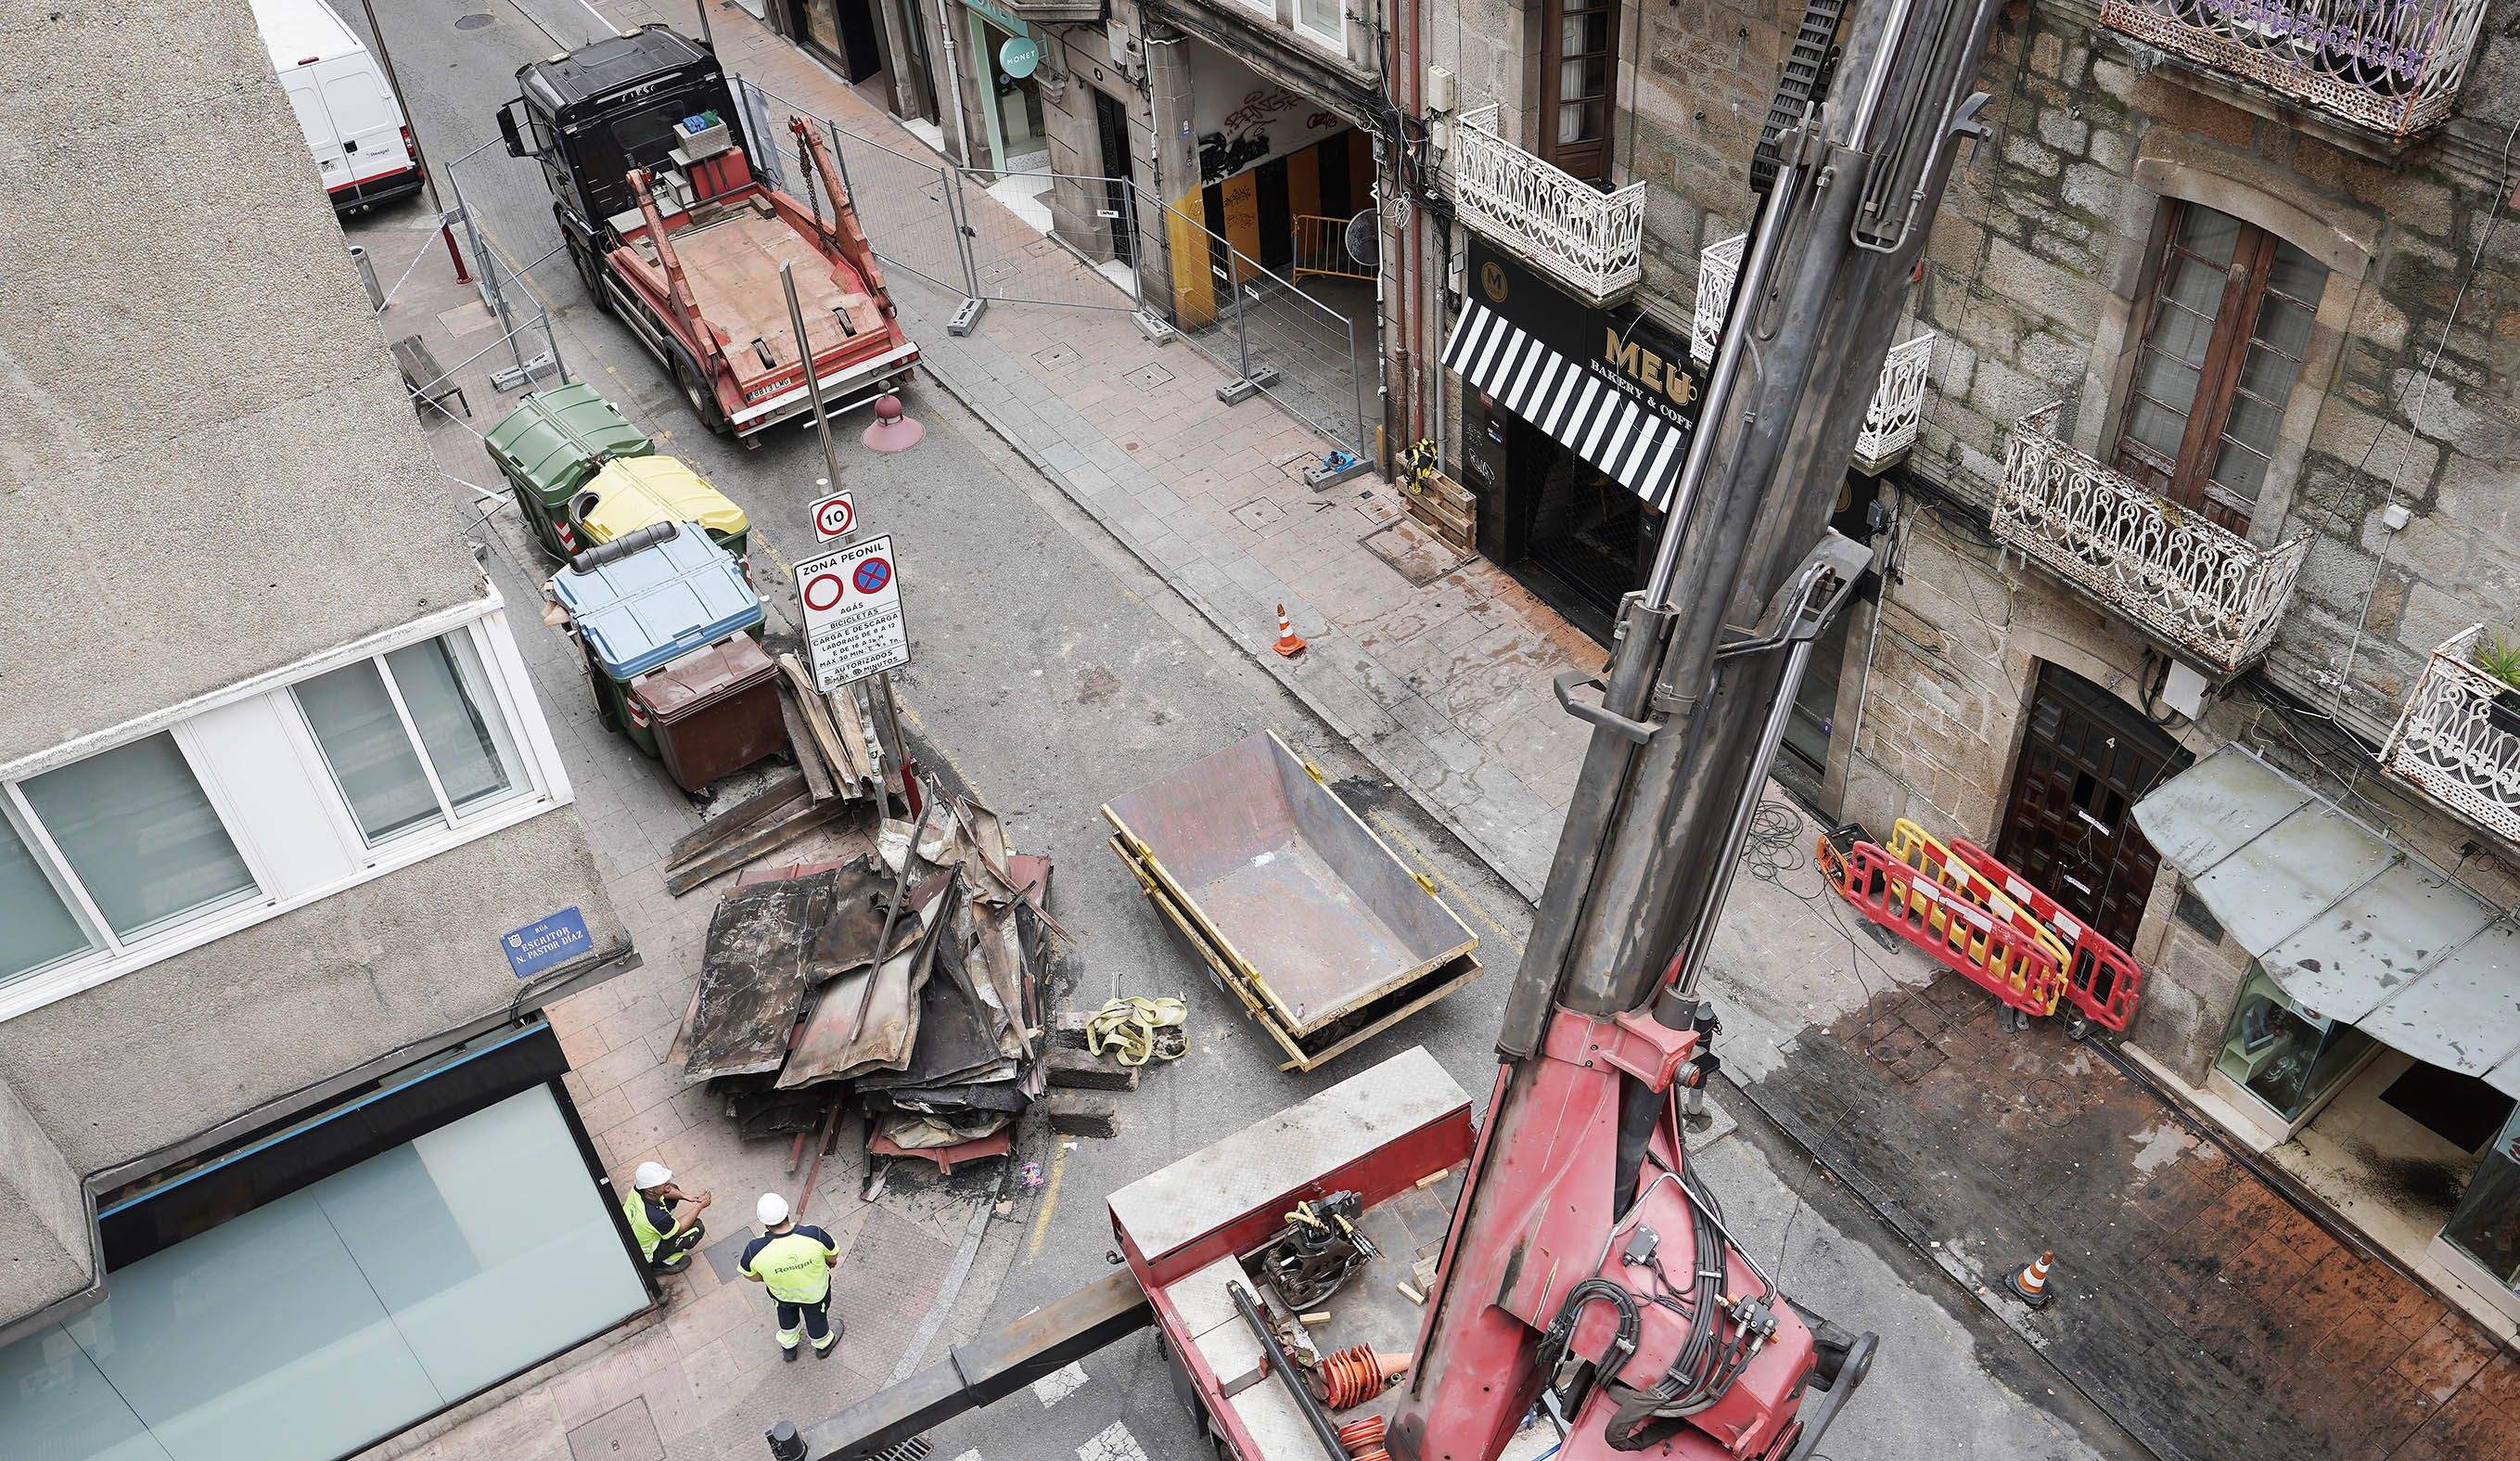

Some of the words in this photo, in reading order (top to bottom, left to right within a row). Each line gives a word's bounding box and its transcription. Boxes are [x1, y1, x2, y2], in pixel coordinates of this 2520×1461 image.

[1006, 50, 1035, 65] MONET
[1604, 327, 1693, 406] MEU
[754, 386, 773, 397] 8813
[1591, 358, 1644, 400] BAKERY
[1646, 396, 1657, 409] &
[825, 510, 845, 526] 10
[802, 558, 838, 576] ZONA
[840, 543, 885, 563] PEONIL
[839, 601, 864, 615] AGÁS
[812, 632, 843, 647] CARGA
[852, 612, 899, 634] DESCARGA
[829, 608, 879, 630] BICICLETAS
[822, 634, 860, 652] LABORAIS
[862, 631, 872, 640] DE
[839, 646, 851, 654] DE
[834, 649, 893, 675] AUTORIZADOS
[863, 656, 899, 673] MINUTOS
[2105, 737, 2116, 749] 4
[516, 955, 527, 965] N.
[527, 941, 561, 960] PASTOR
[560, 929, 584, 945] DÍAZ
[520, 927, 570, 953] ESCRITOR
[774, 1259, 812, 1275] Resigal
